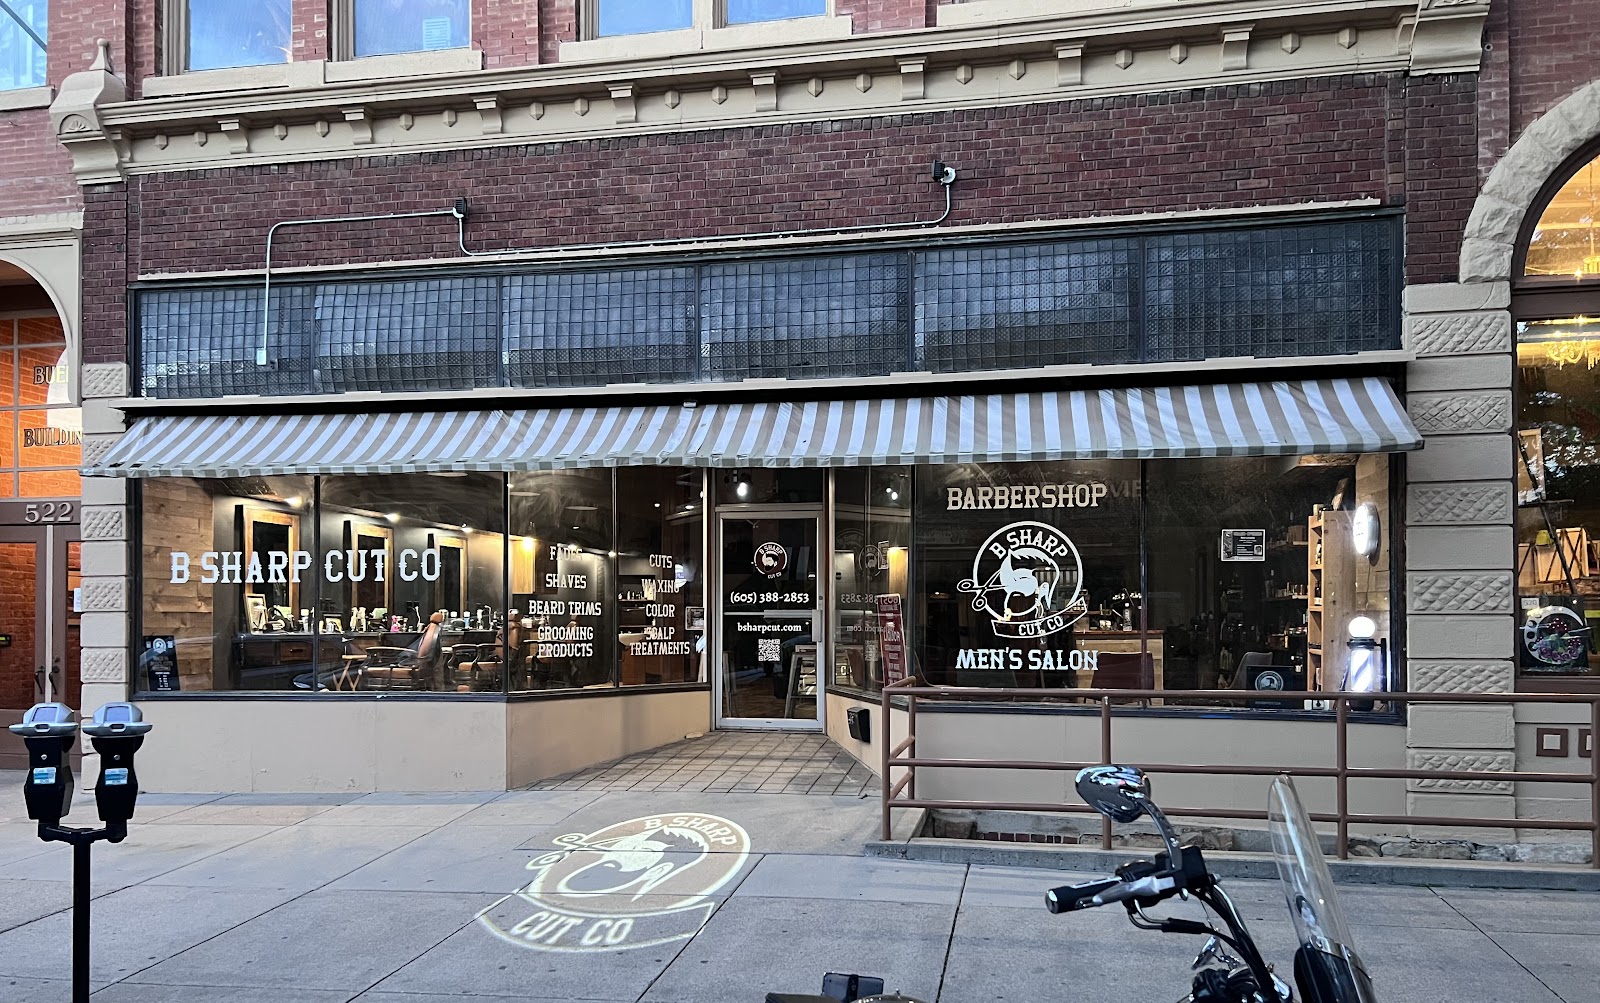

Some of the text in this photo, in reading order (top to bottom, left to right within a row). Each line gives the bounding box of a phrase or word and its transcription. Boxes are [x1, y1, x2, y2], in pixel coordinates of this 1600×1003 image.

[23, 426, 82, 447] BUILDIN
[946, 483, 1108, 511] BARBERSHOP
[25, 503, 73, 523] 522
[988, 529, 1069, 559] B SHARP
[170, 548, 442, 584] B SHARP CUT CO
[649, 554, 673, 569] CUTS
[545, 573, 587, 589] SHAVES
[641, 578, 680, 593] WAXING
[730, 591, 810, 604] (605) 388-2853
[528, 600, 602, 616] BEARD TRIMS
[645, 604, 676, 618] COLOR
[537, 626, 594, 641] GROOMING
[645, 626, 675, 641] SCALP
[737, 621, 802, 634] bsharpcut.com
[1018, 616, 1064, 636] CUT CO
[538, 642, 593, 658] PRODUCTS
[629, 641, 690, 656] TREATMENTS
[955, 647, 1099, 671] MEN'S SALON
[643, 816, 738, 847] B SHARP
[510, 911, 634, 945] CUT CO
